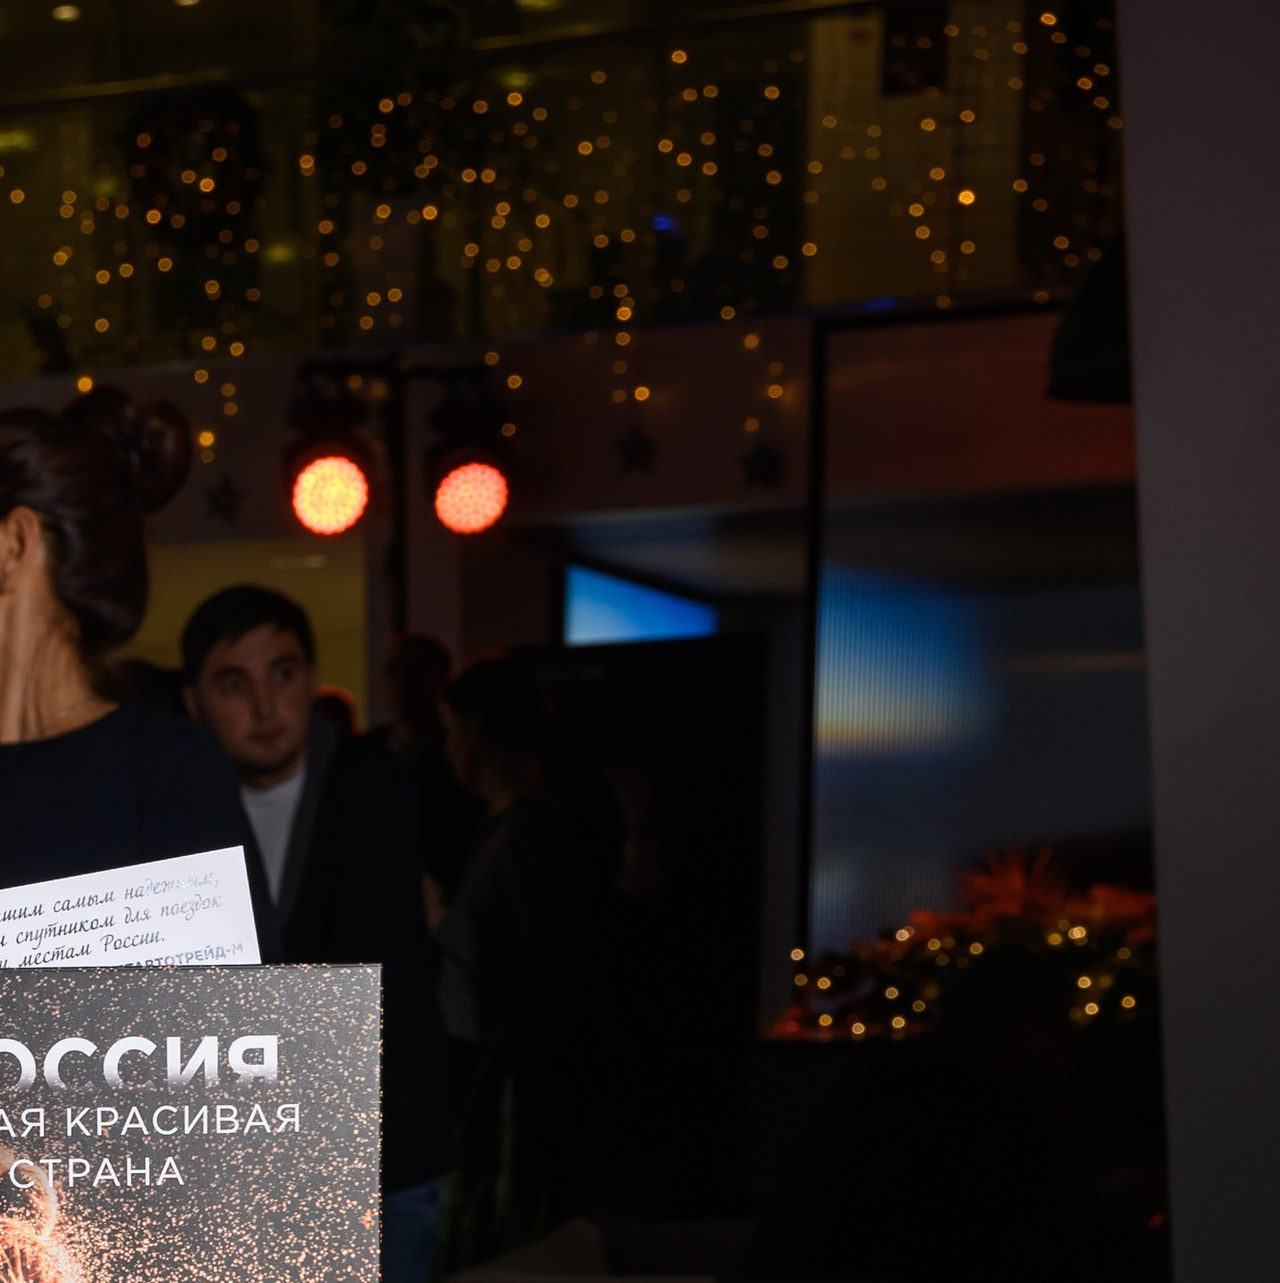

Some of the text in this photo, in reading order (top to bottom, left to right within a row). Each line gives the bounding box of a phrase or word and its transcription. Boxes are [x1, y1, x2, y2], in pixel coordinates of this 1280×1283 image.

[53, 890, 116, 913] самым
[15, 915, 116, 950] спутником
[124, 906, 152, 924] для
[160, 893, 224, 921] поездок
[18, 943, 92, 967] местам
[100, 931, 166, 952] России.
[66, 1102, 302, 1137] КРАСИВАЯ
[8, 1156, 186, 1189] СТРАНА
